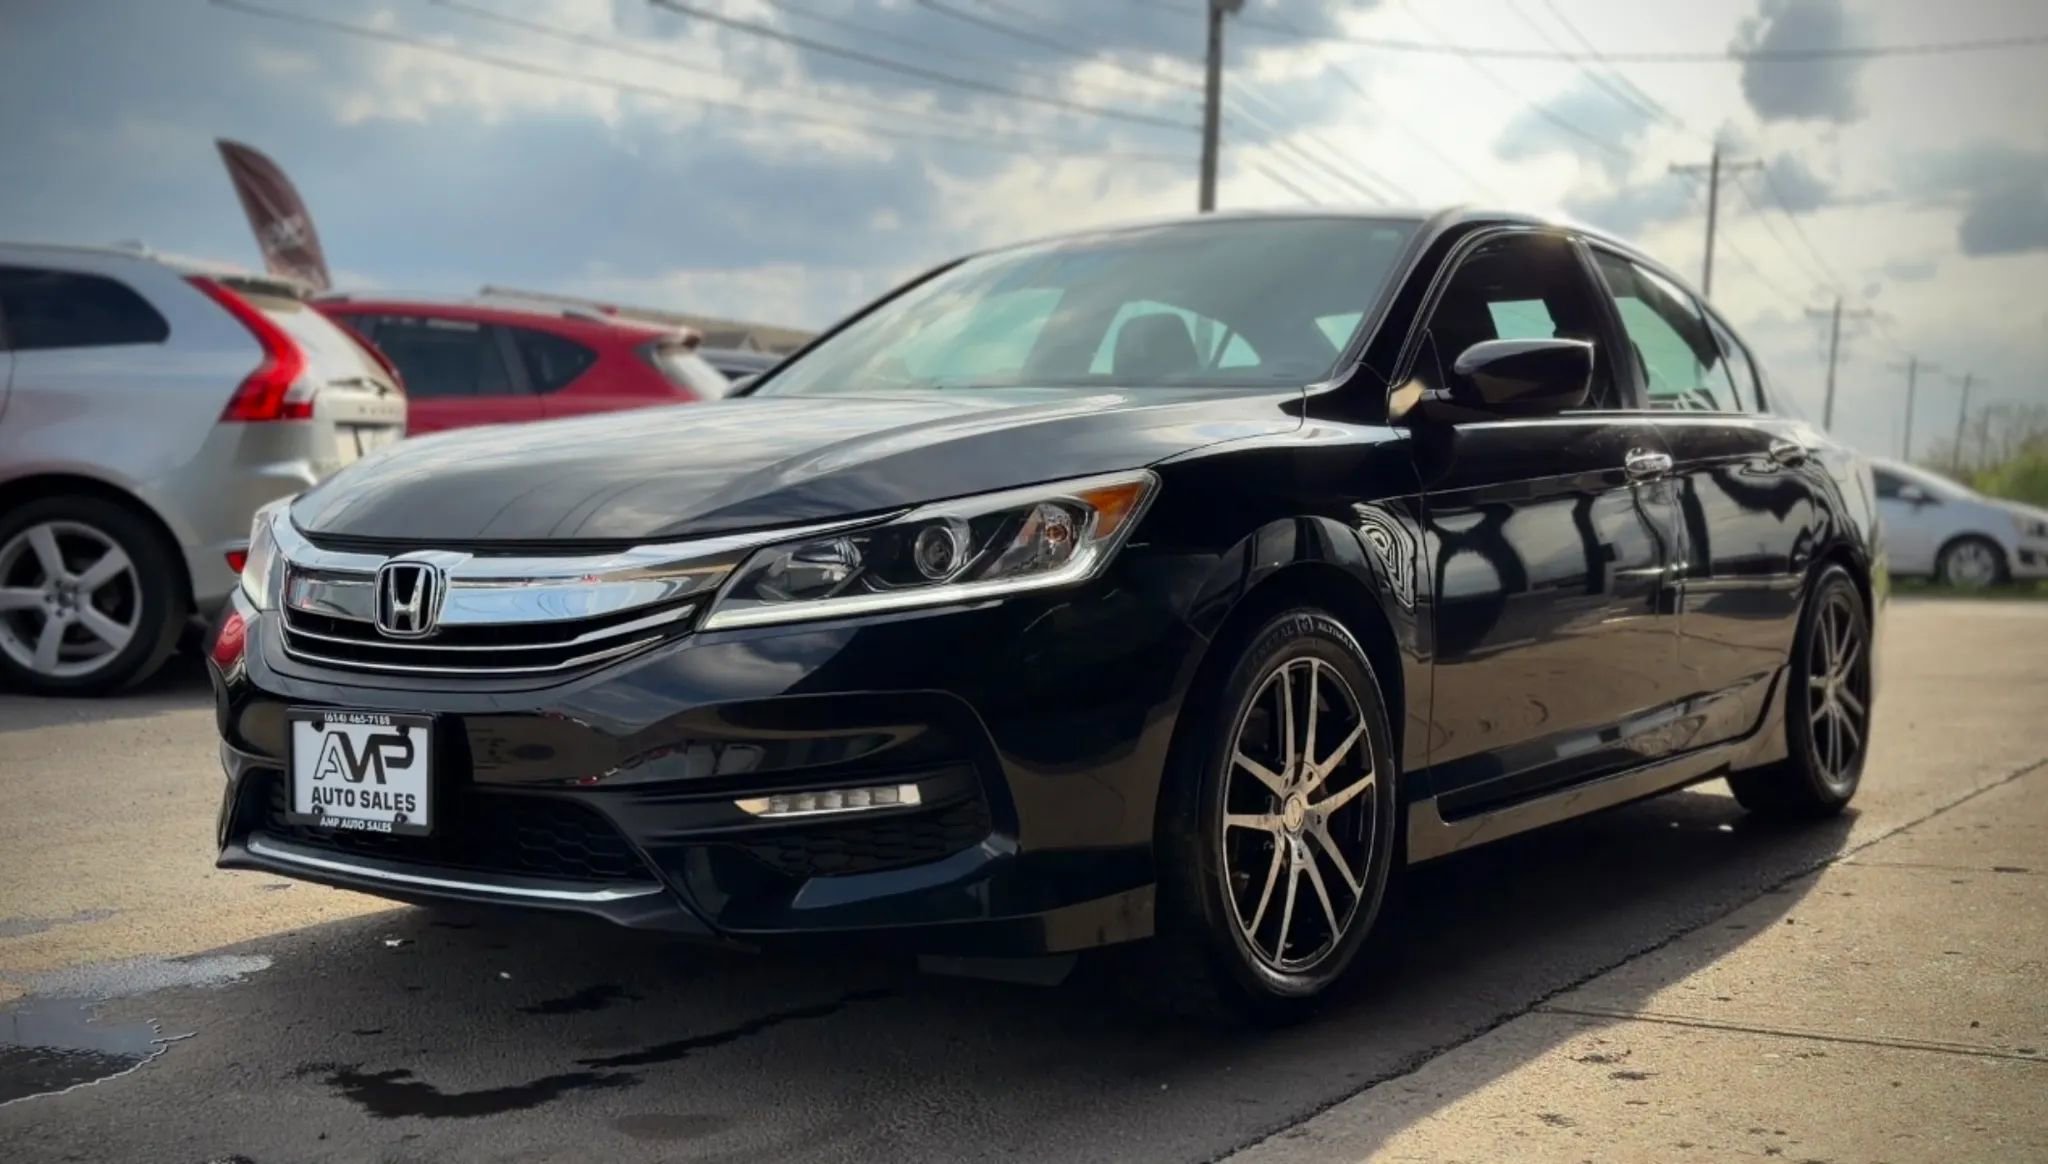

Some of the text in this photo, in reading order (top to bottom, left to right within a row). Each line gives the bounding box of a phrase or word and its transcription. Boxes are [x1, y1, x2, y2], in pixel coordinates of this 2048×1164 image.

[313, 731, 414, 785] AMP
[311, 786, 416, 813] AUTO SALES
[319, 815, 392, 833] AMP AUTO SALES
